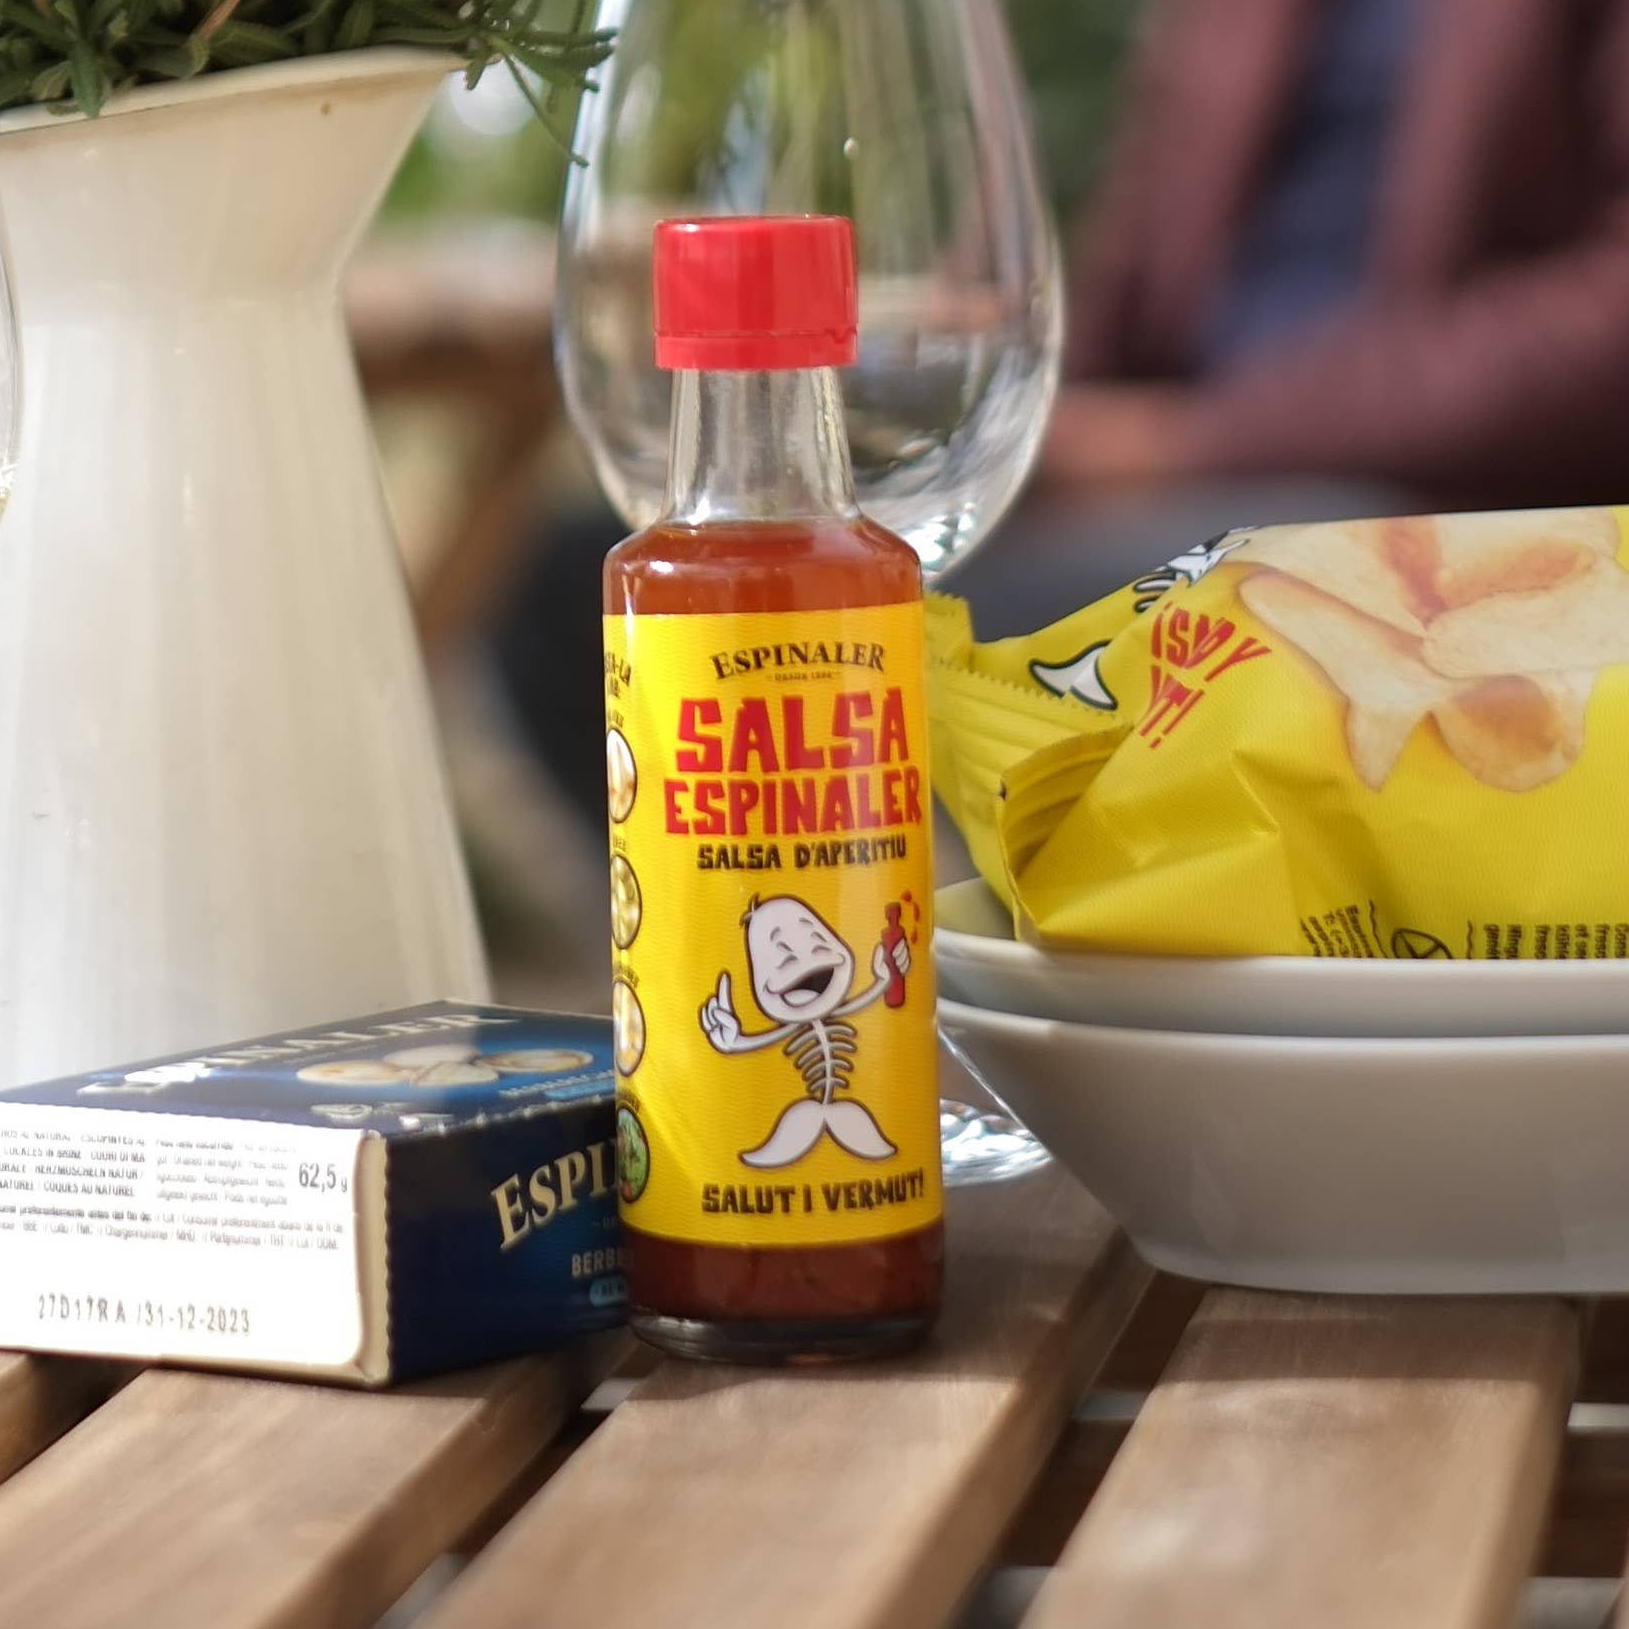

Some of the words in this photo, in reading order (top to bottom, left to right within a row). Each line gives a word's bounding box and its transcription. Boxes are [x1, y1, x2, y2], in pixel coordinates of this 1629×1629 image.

[710, 641, 886, 681] ESPINALER
[675, 686, 910, 773] SALSA
[663, 765, 922, 837] ESPINALER
[697, 843, 783, 870] SALSA
[794, 835, 908, 870] D'APERITIU
[299, 1162, 337, 1193] 62,5
[701, 1182, 795, 1214] SALUT
[802, 1183, 813, 1214] I
[821, 1166, 924, 1212] VERMUT!
